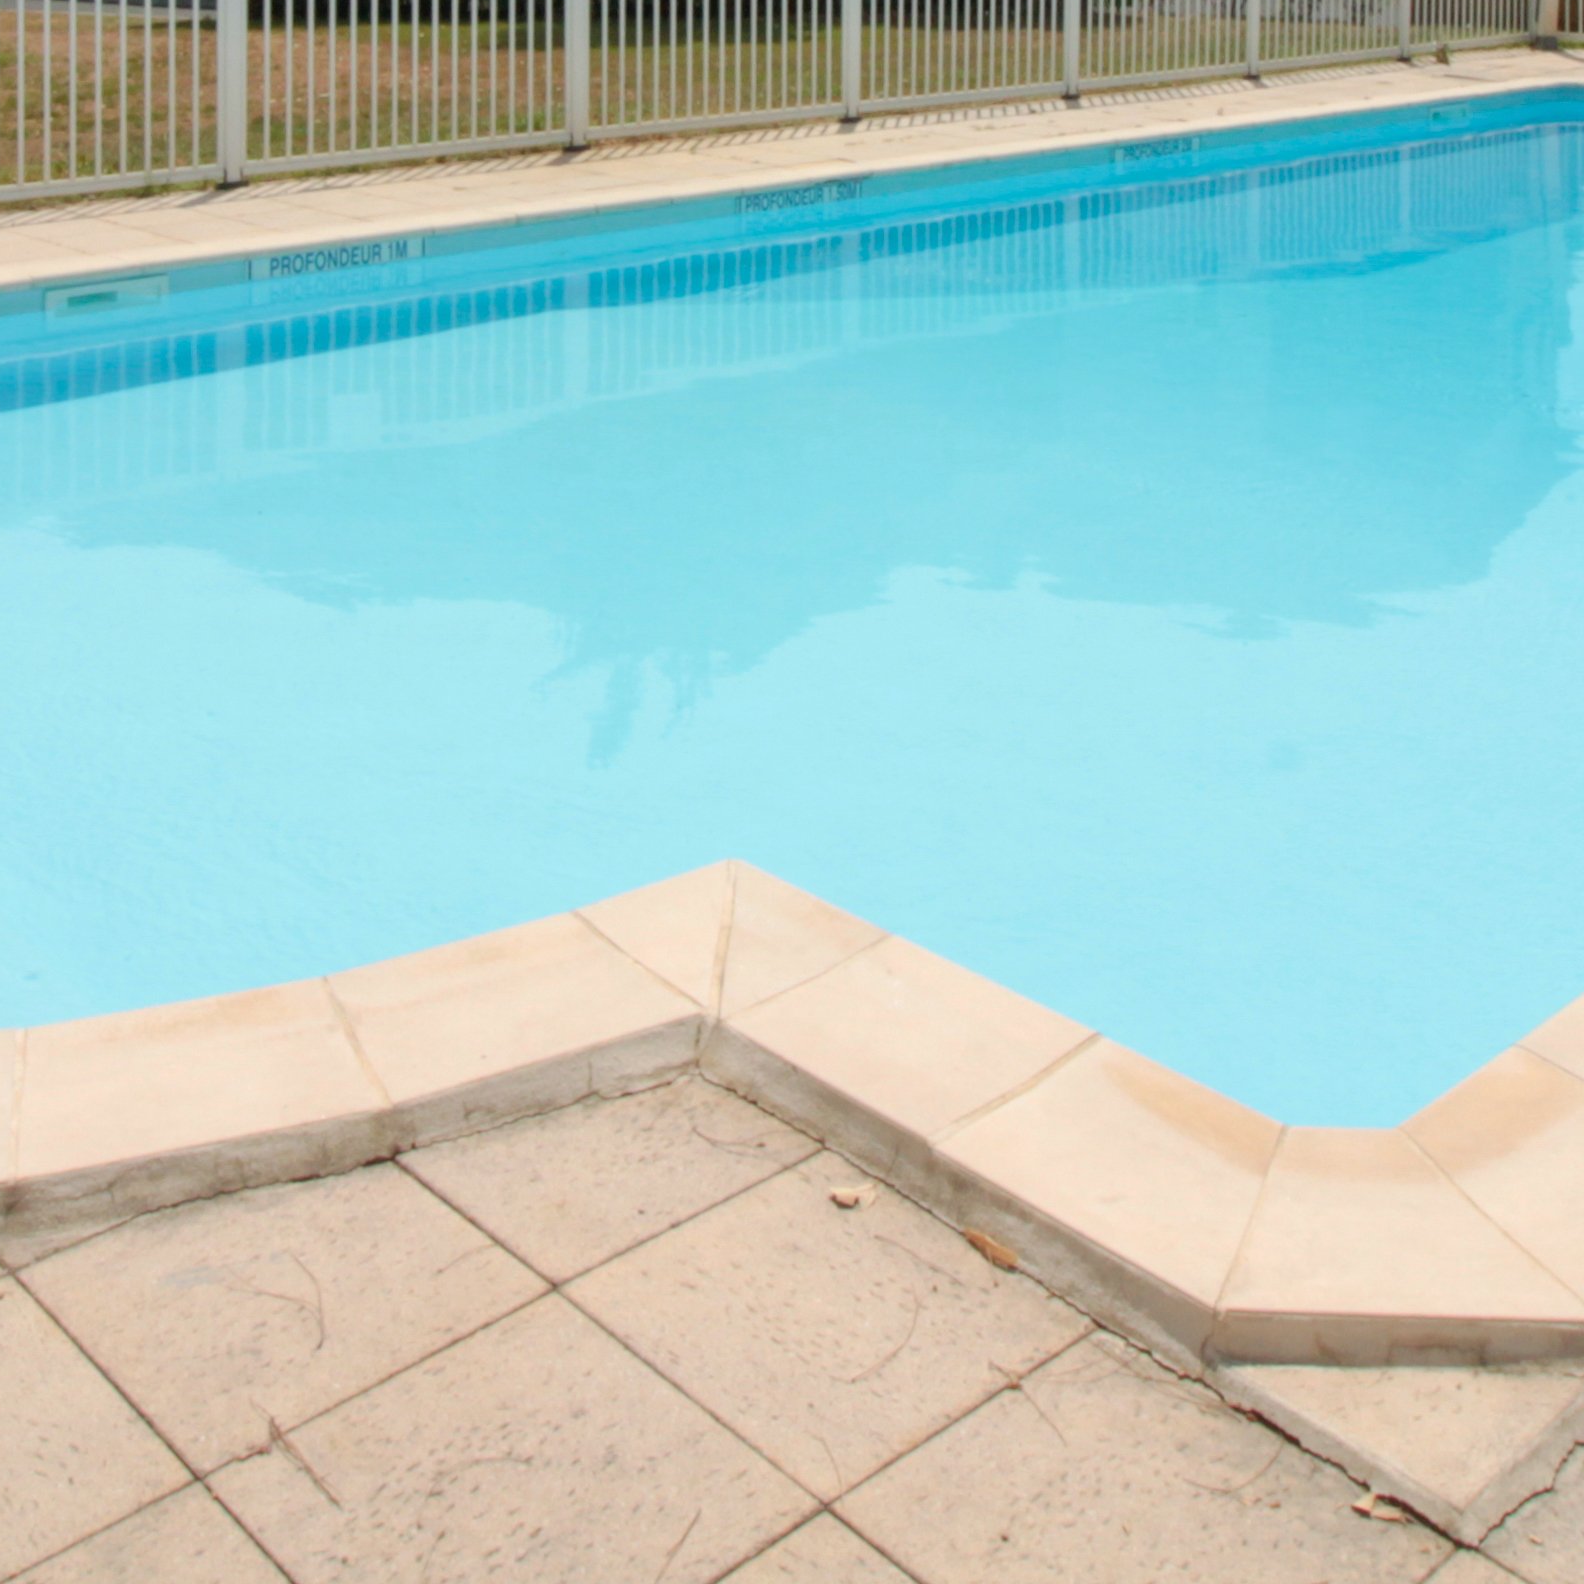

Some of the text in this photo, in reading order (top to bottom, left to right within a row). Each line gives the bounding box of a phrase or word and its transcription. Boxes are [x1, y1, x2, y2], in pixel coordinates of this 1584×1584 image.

[745, 184, 824, 213] PROFONDEUR
[269, 240, 409, 278] PROFONDEUR 1M
